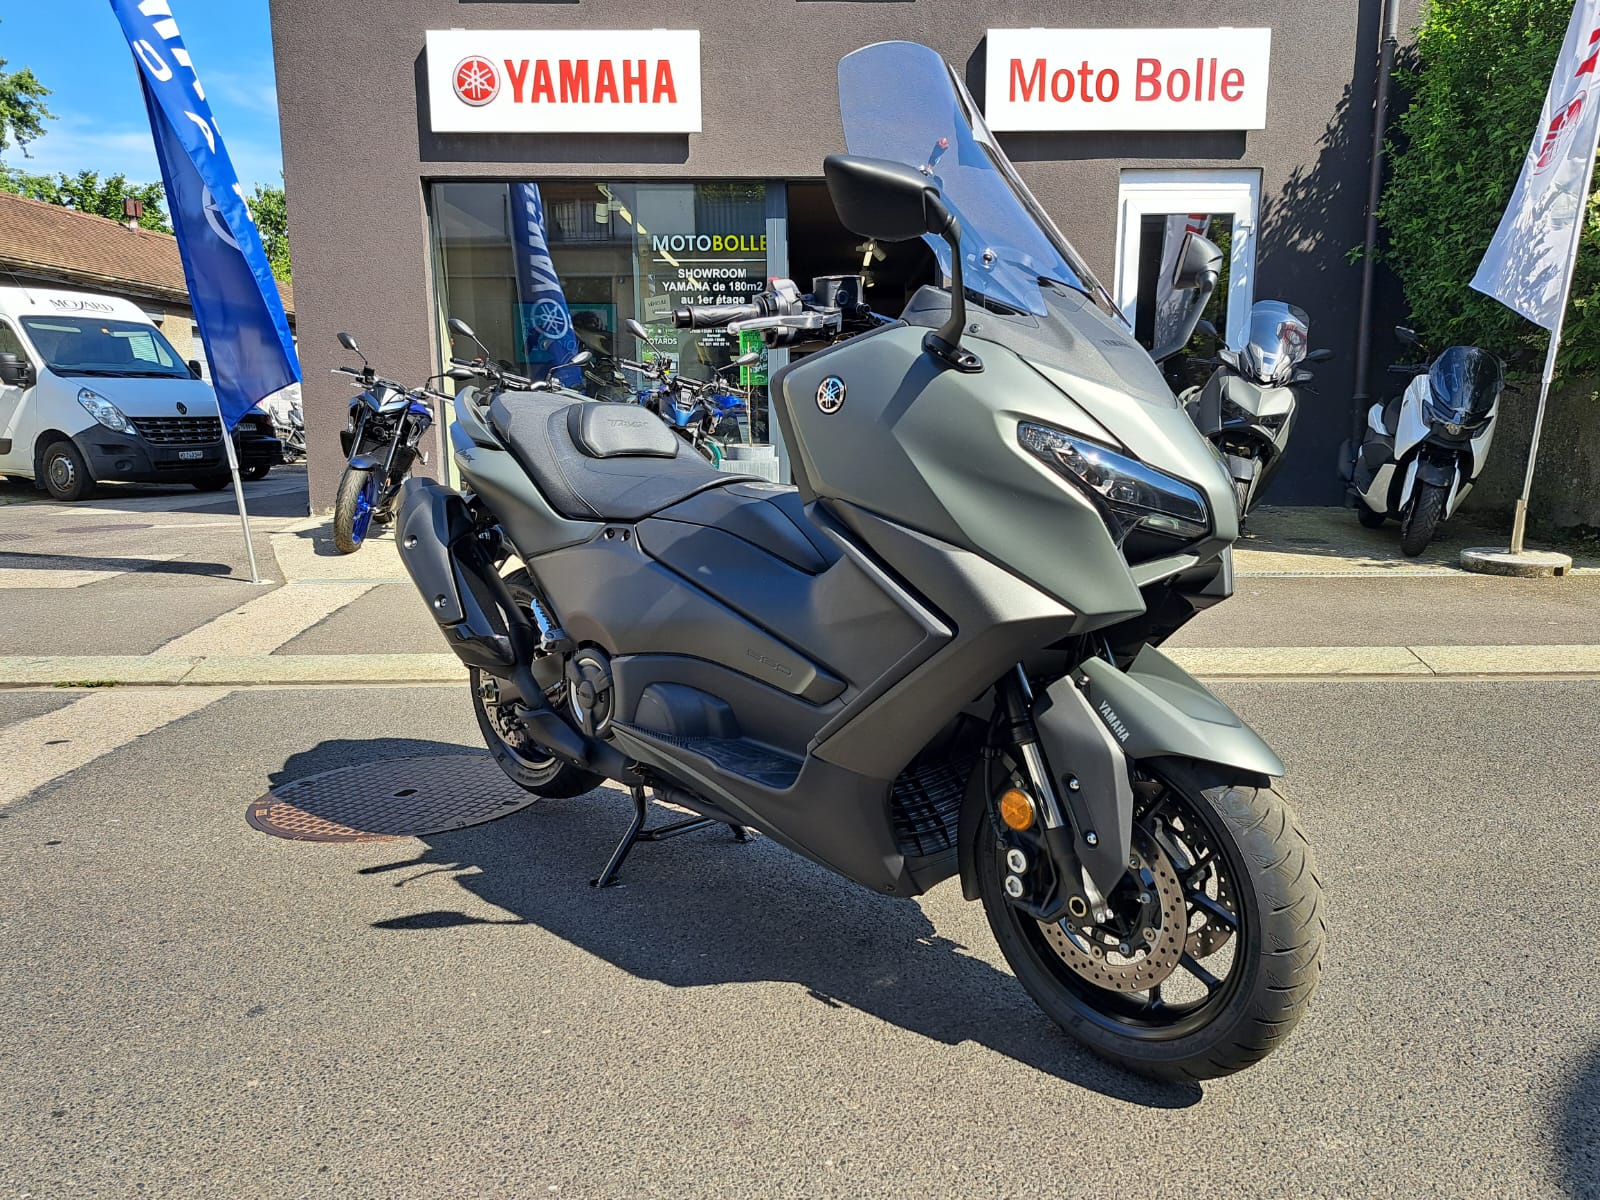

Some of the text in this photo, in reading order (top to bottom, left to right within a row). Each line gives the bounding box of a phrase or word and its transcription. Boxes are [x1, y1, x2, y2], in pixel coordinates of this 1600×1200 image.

[504, 59, 677, 103] YAMAHA
[1009, 57, 1245, 102] Moto Bolle
[662, 281, 763, 291] YAMAHA de 180m2
[678, 268, 747, 279] SHOWROOM
[681, 296, 694, 304] au
[698, 295, 713, 304] 1er
[1098, 700, 1130, 742] YAMAHA
